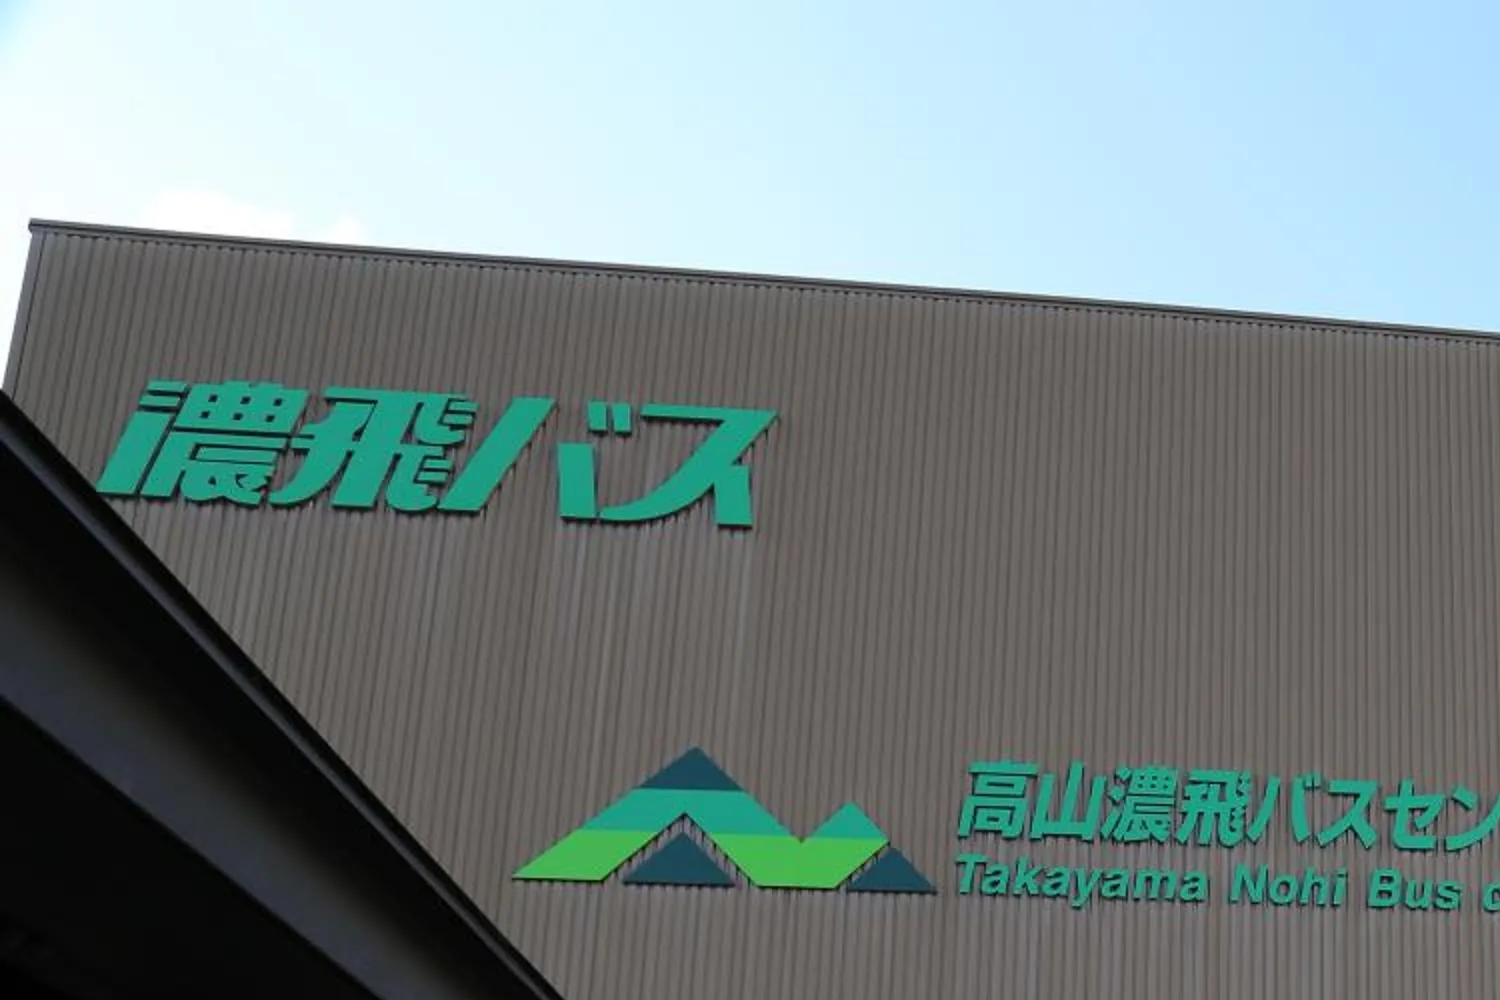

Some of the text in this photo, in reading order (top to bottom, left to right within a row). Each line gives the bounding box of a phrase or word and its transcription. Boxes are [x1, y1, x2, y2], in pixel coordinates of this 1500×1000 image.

[96, 380, 780, 527] 濃飛バス
[956, 853, 1209, 908] Takayama
[1229, 863, 1347, 907] Nohi
[1368, 867, 1463, 912] Bus
